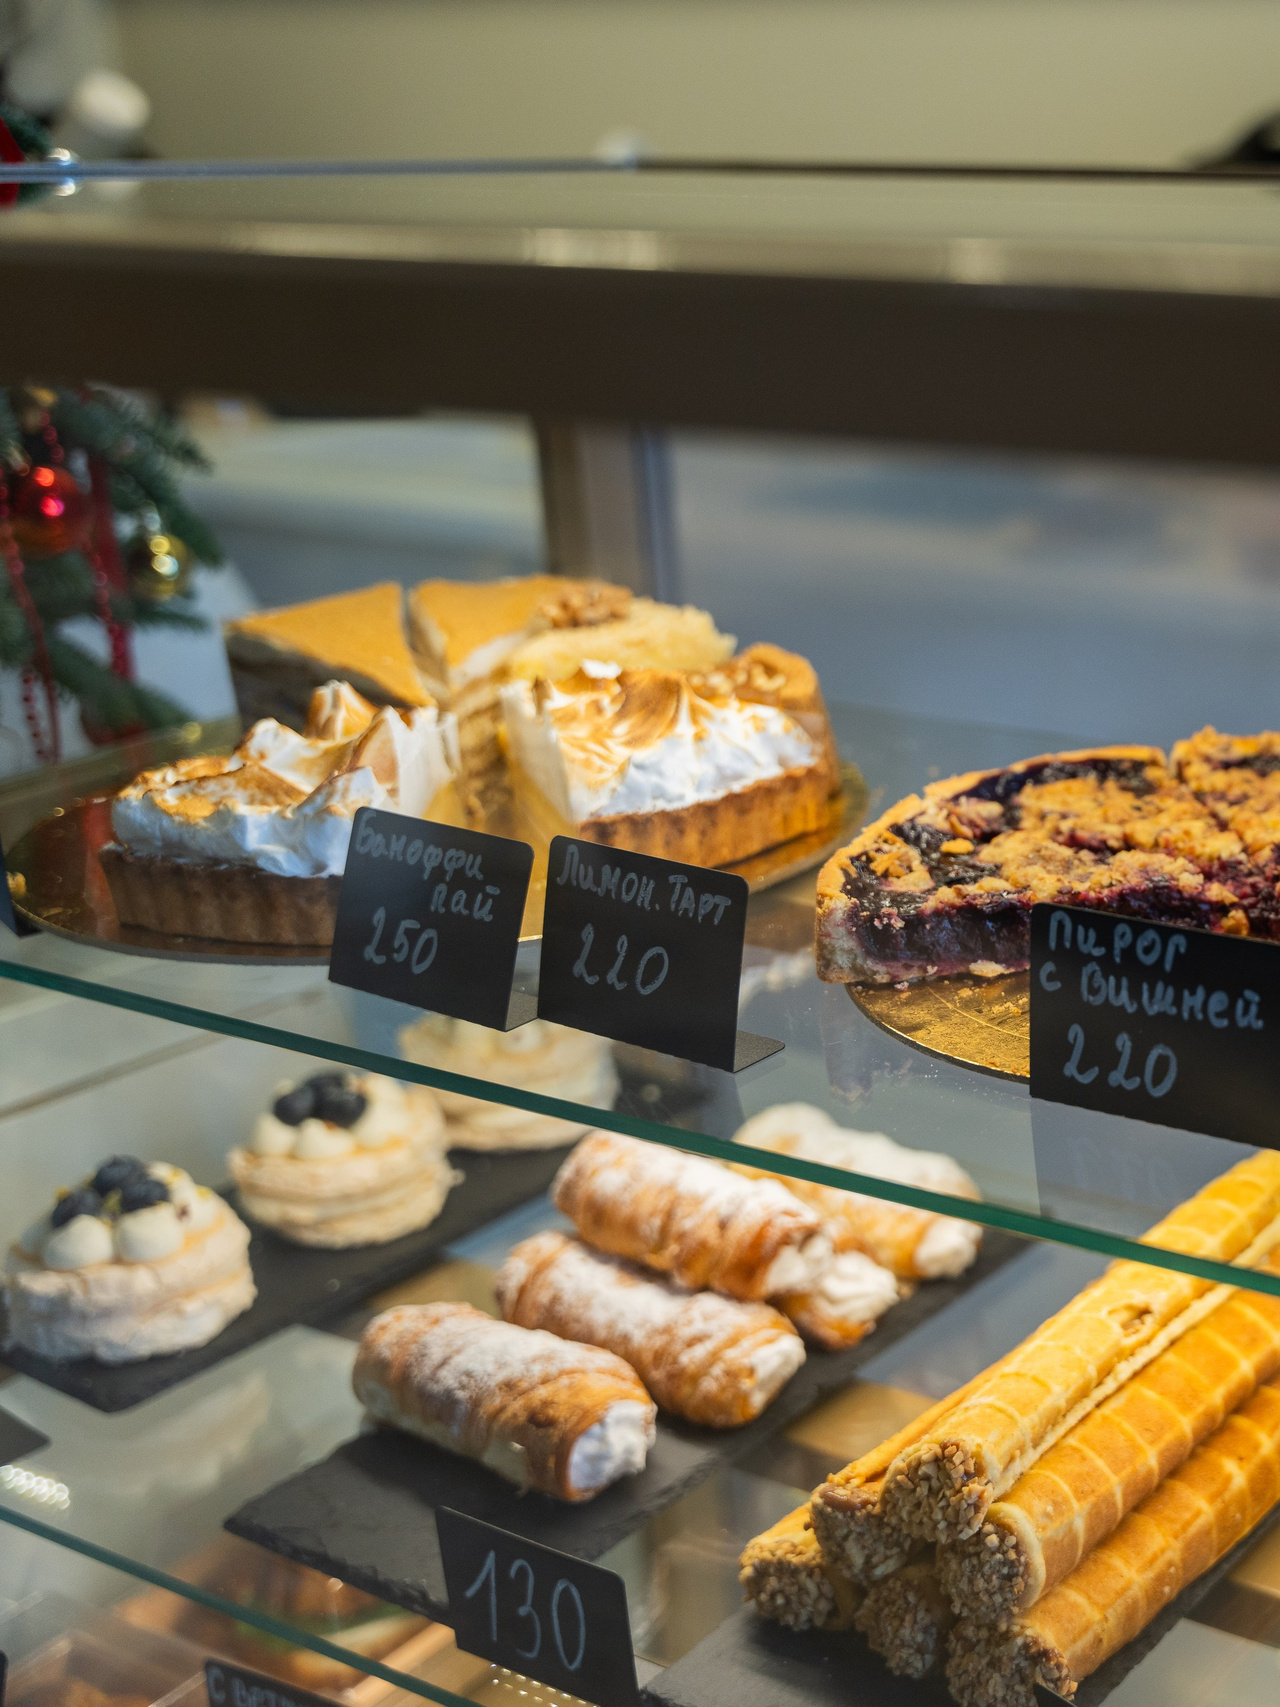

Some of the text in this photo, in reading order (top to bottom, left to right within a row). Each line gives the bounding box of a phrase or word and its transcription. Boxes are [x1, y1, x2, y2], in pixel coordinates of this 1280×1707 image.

[363, 906, 438, 974] 250
[572, 922, 669, 995] 220
[1049, 910, 1187, 973] Пирог
[1062, 1023, 1178, 1098] 220
[464, 1550, 586, 1672] 130
